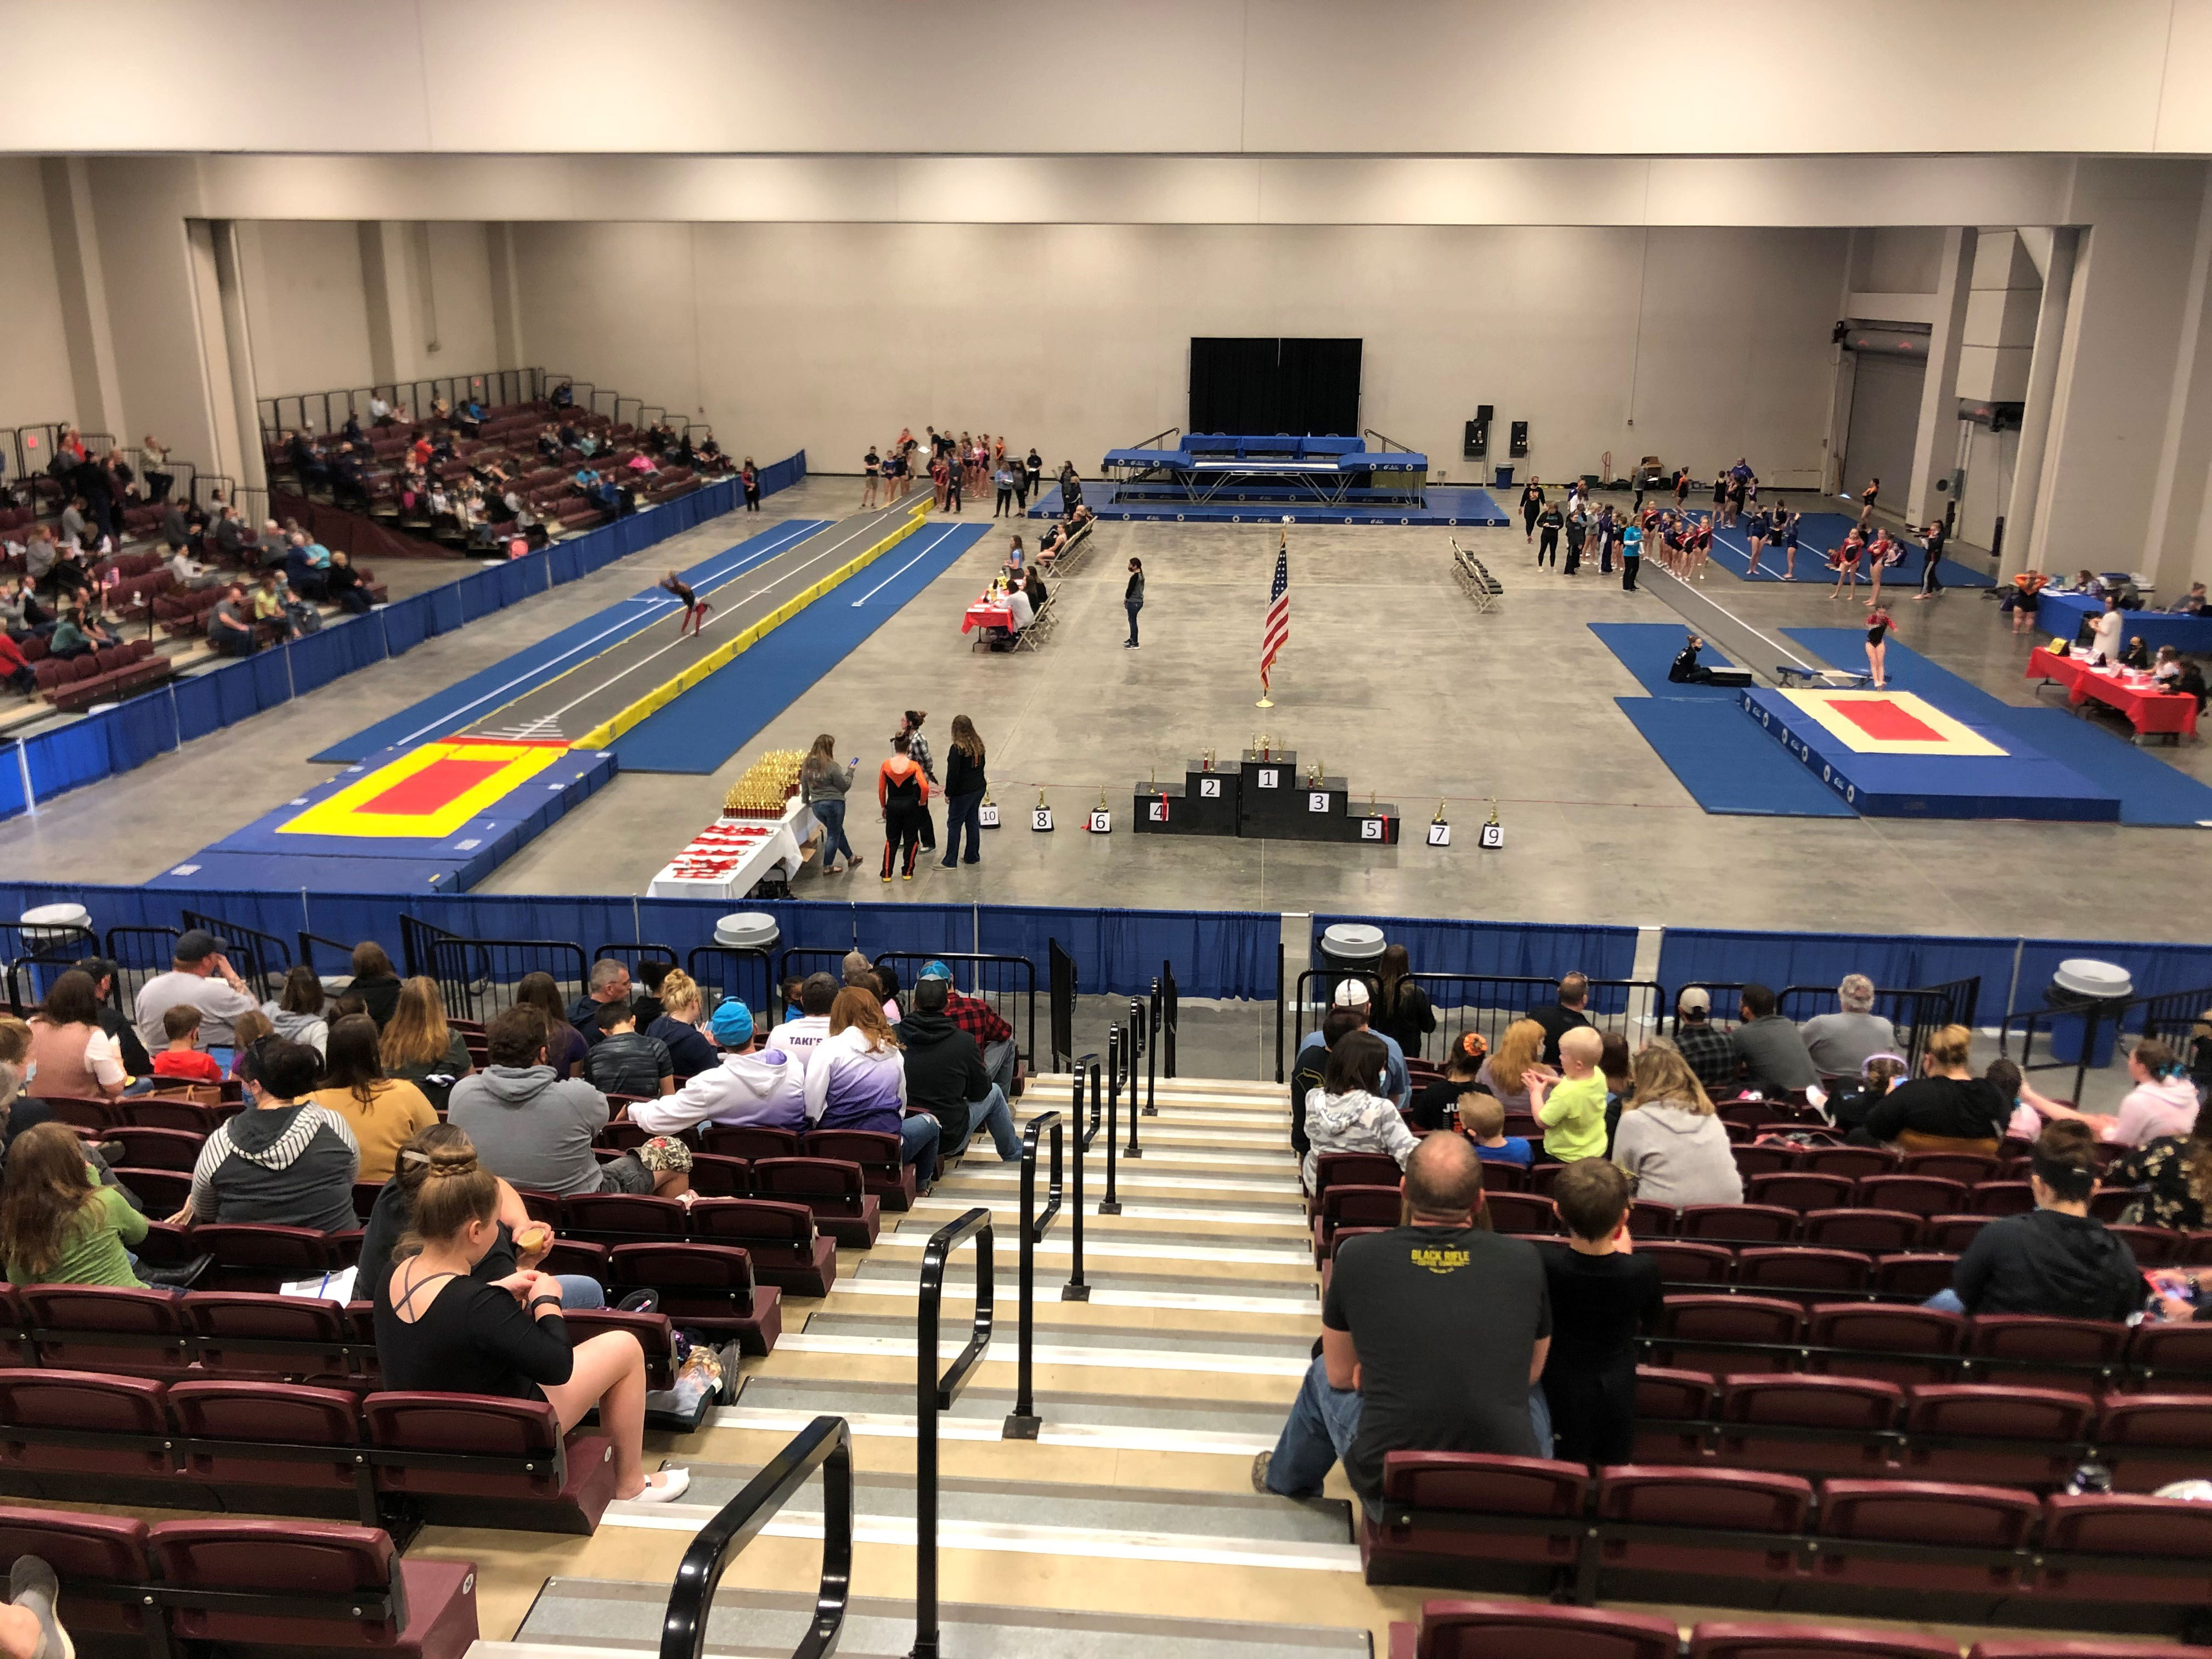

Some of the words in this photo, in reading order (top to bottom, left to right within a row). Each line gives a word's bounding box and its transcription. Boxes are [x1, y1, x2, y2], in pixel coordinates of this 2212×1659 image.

[1263, 771, 1273, 786] 1
[1205, 781, 1215, 795] 2
[1314, 795, 1324, 810] 3
[983, 811, 996, 821] 10
[1037, 812, 1047, 827] 8
[1154, 805, 1163, 819] 4
[1096, 814, 1105, 829] 6
[1366, 822, 1376, 837] 5
[1435, 827, 1445, 842] 7
[1488, 829, 1499, 844] 9
